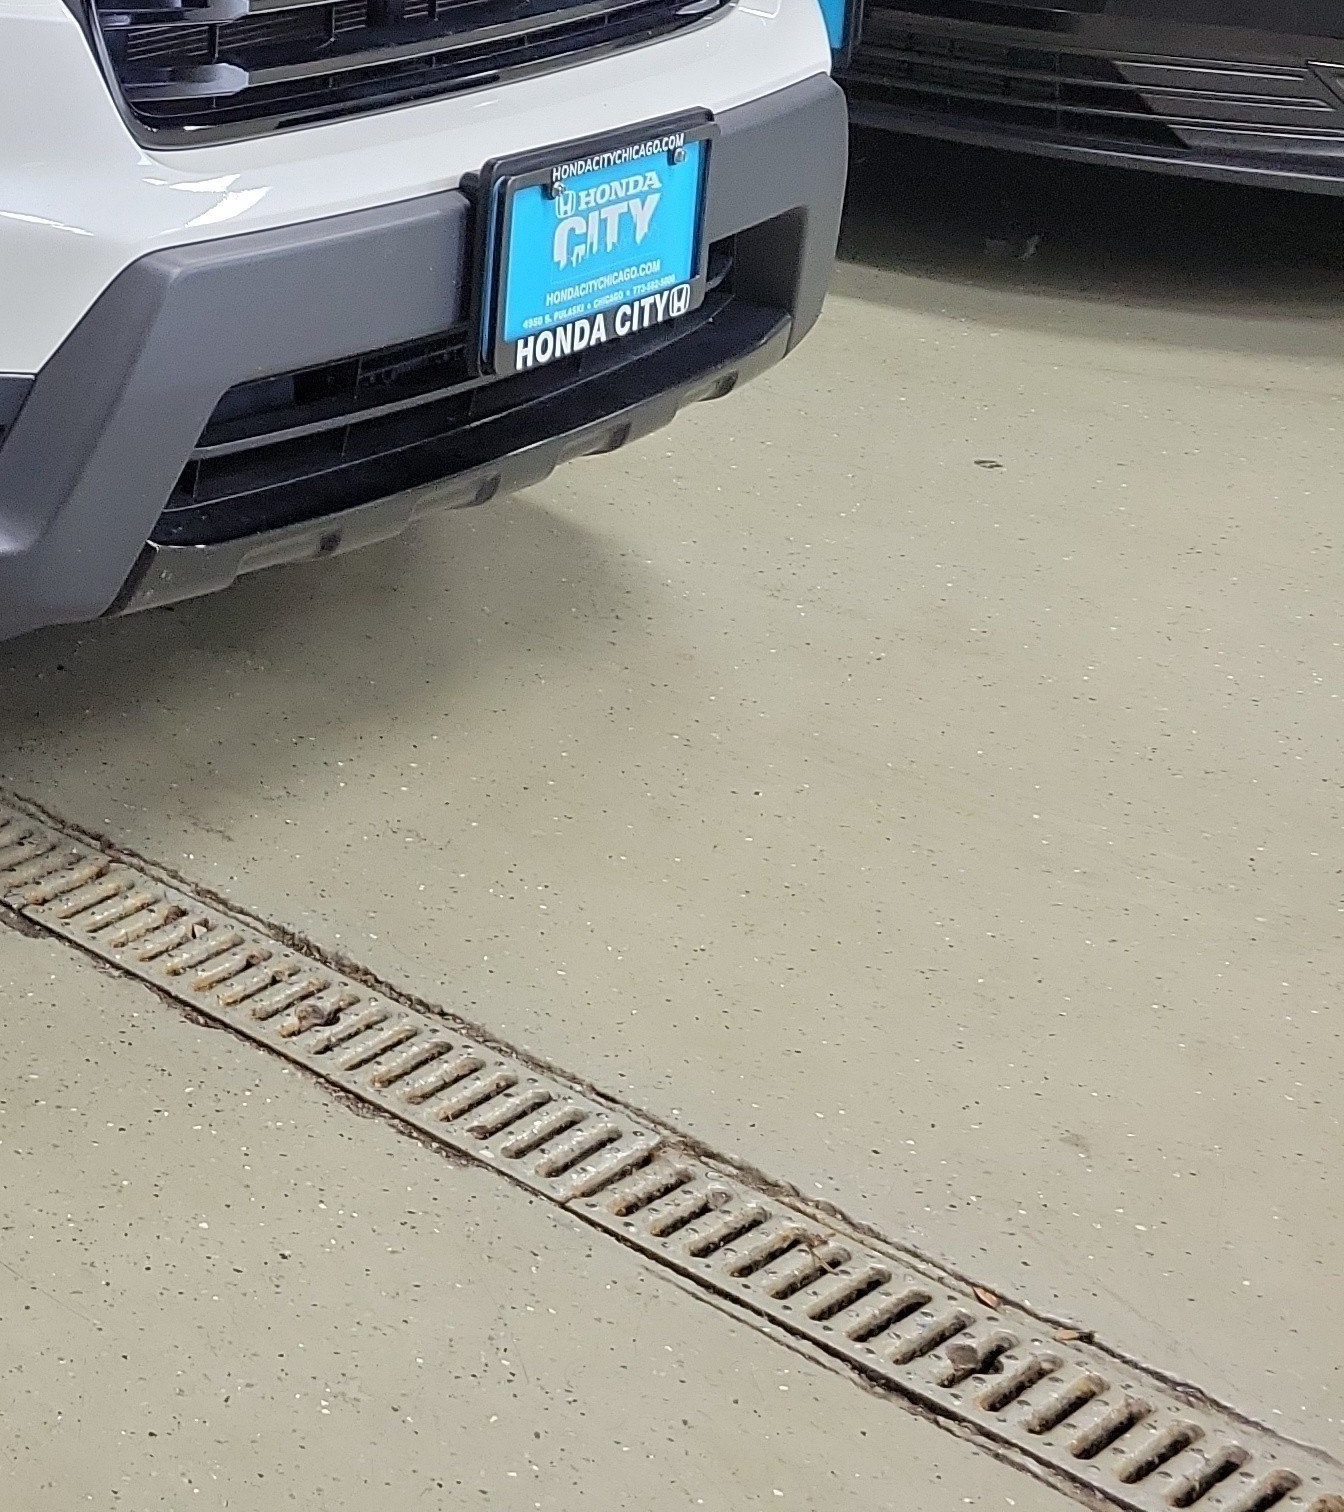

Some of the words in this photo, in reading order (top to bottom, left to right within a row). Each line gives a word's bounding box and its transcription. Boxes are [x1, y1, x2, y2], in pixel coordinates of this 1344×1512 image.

[552, 133, 684, 181] HONDACITYCHICAGO.COM
[578, 171, 662, 210] HONDA
[553, 193, 662, 271] CITY
[545, 259, 661, 307] HONDACITYCHICAGO.COM
[515, 313, 607, 371] HONDA
[615, 290, 670, 336] CITY
